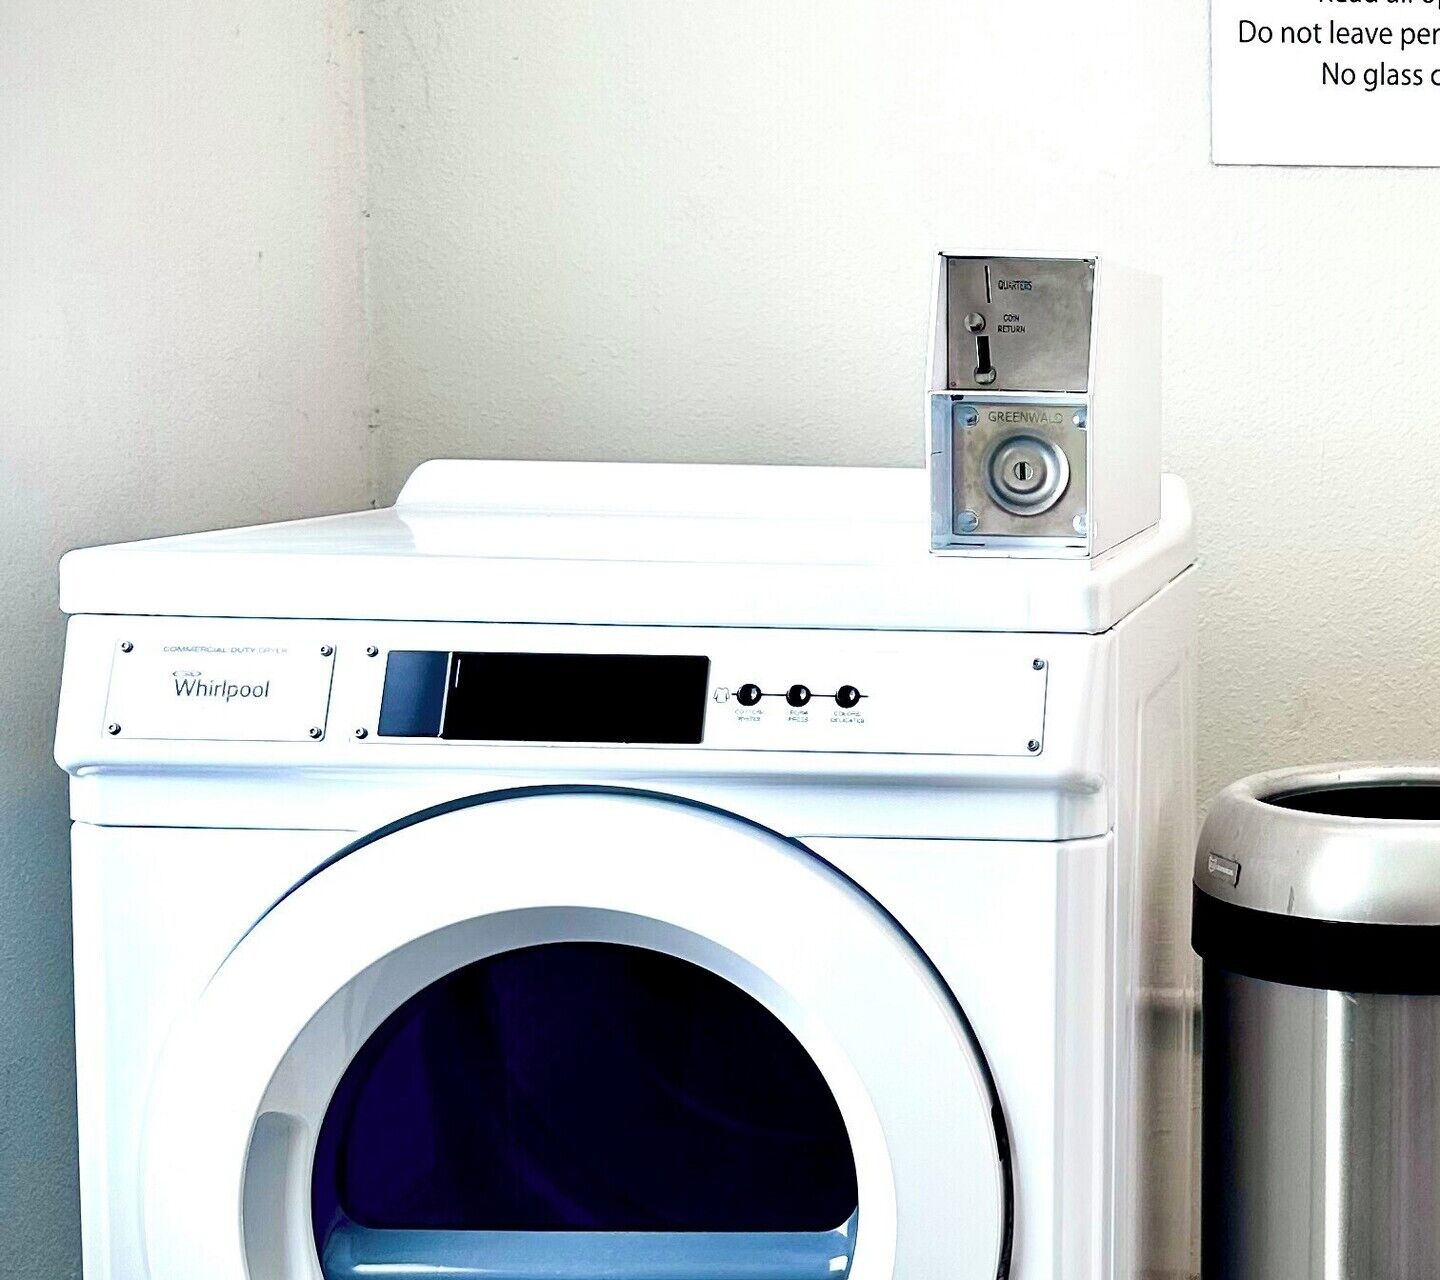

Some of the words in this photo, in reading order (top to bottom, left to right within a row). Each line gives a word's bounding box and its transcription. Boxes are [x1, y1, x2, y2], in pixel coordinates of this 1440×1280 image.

[1239, 19, 1273, 44] Do
[1281, 23, 1323, 44] not
[1329, 19, 1393, 45] leave
[1322, 61, 1356, 86] No
[1363, 61, 1423, 93] glass
[998, 280, 1032, 290] QUARTERS
[998, 325, 1026, 333] RETURN
[988, 411, 1063, 424] GREENWALD
[174, 678, 270, 703] Whirlpool
